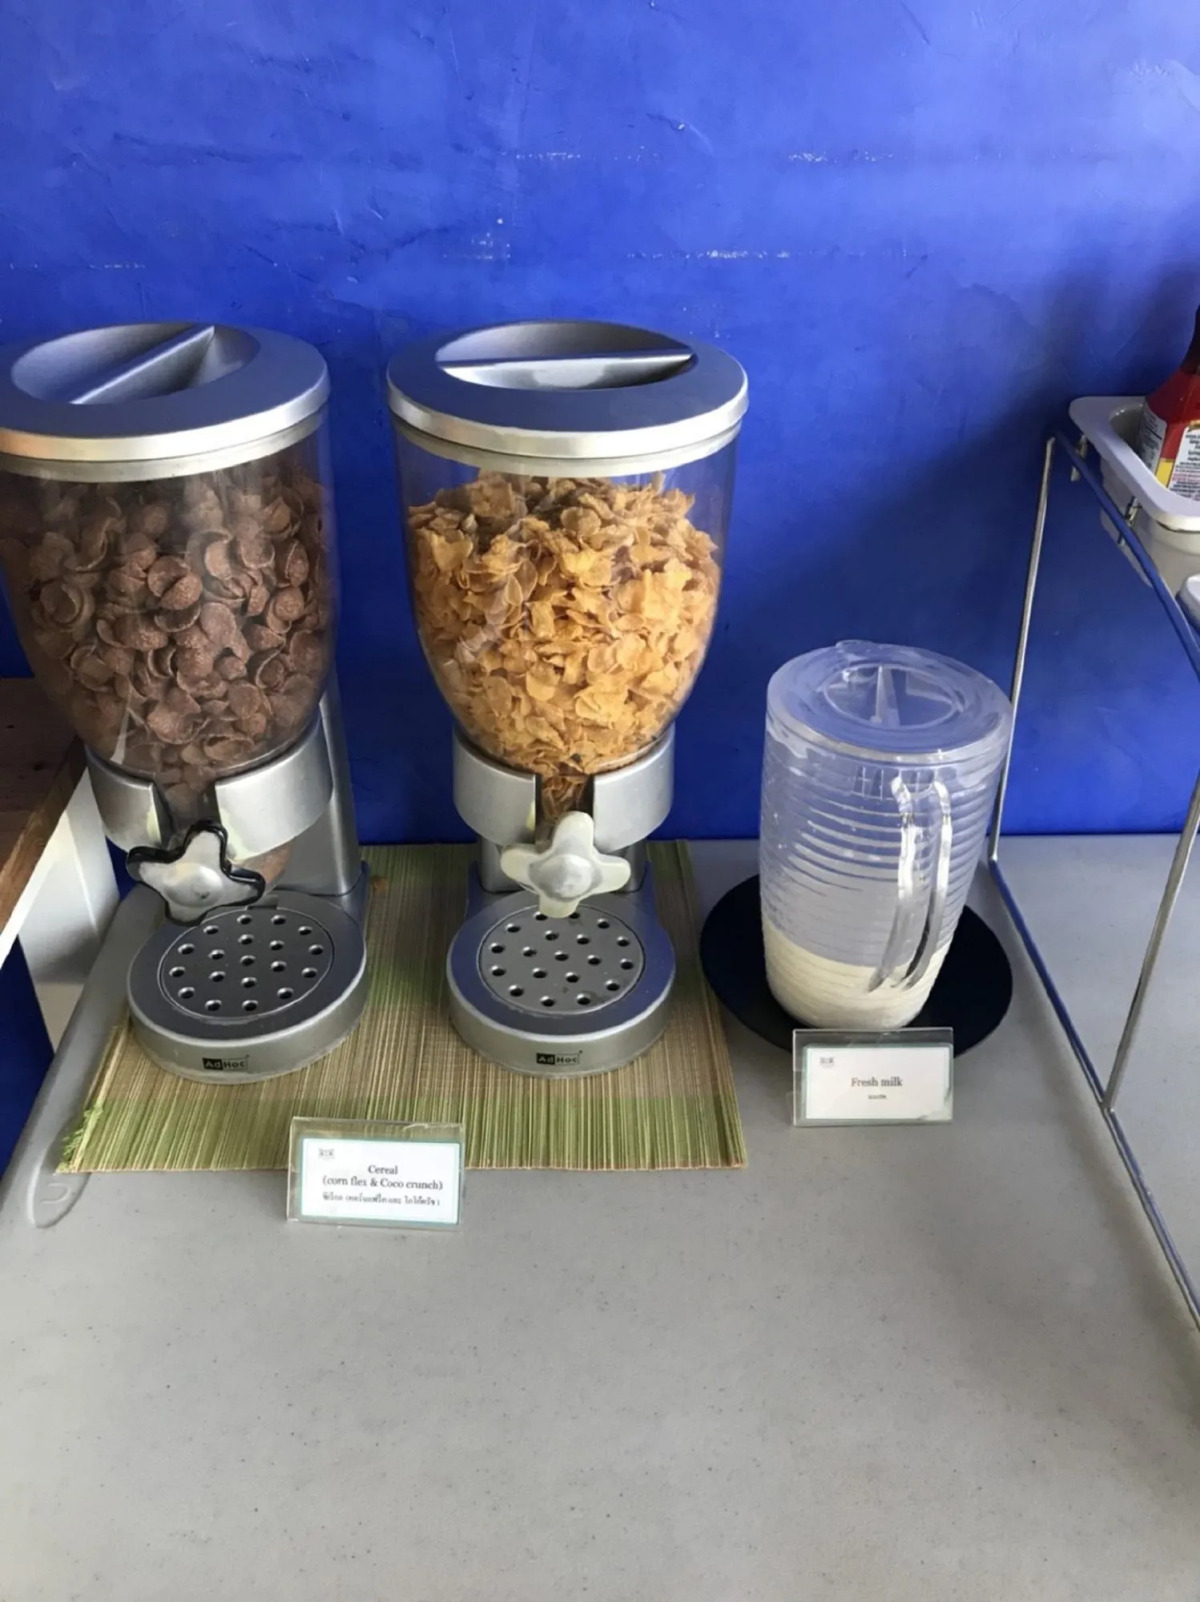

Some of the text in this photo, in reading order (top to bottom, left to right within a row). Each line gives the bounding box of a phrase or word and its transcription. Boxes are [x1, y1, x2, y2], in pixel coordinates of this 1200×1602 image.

[851, 1076, 903, 1087] Fresh milk
[368, 1164, 398, 1175] Cereal
[322, 1175, 348, 1186] (corn
[370, 1177, 378, 1188] &
[380, 1178, 404, 1189] Coco
[406, 1179, 443, 1190] crunch)
